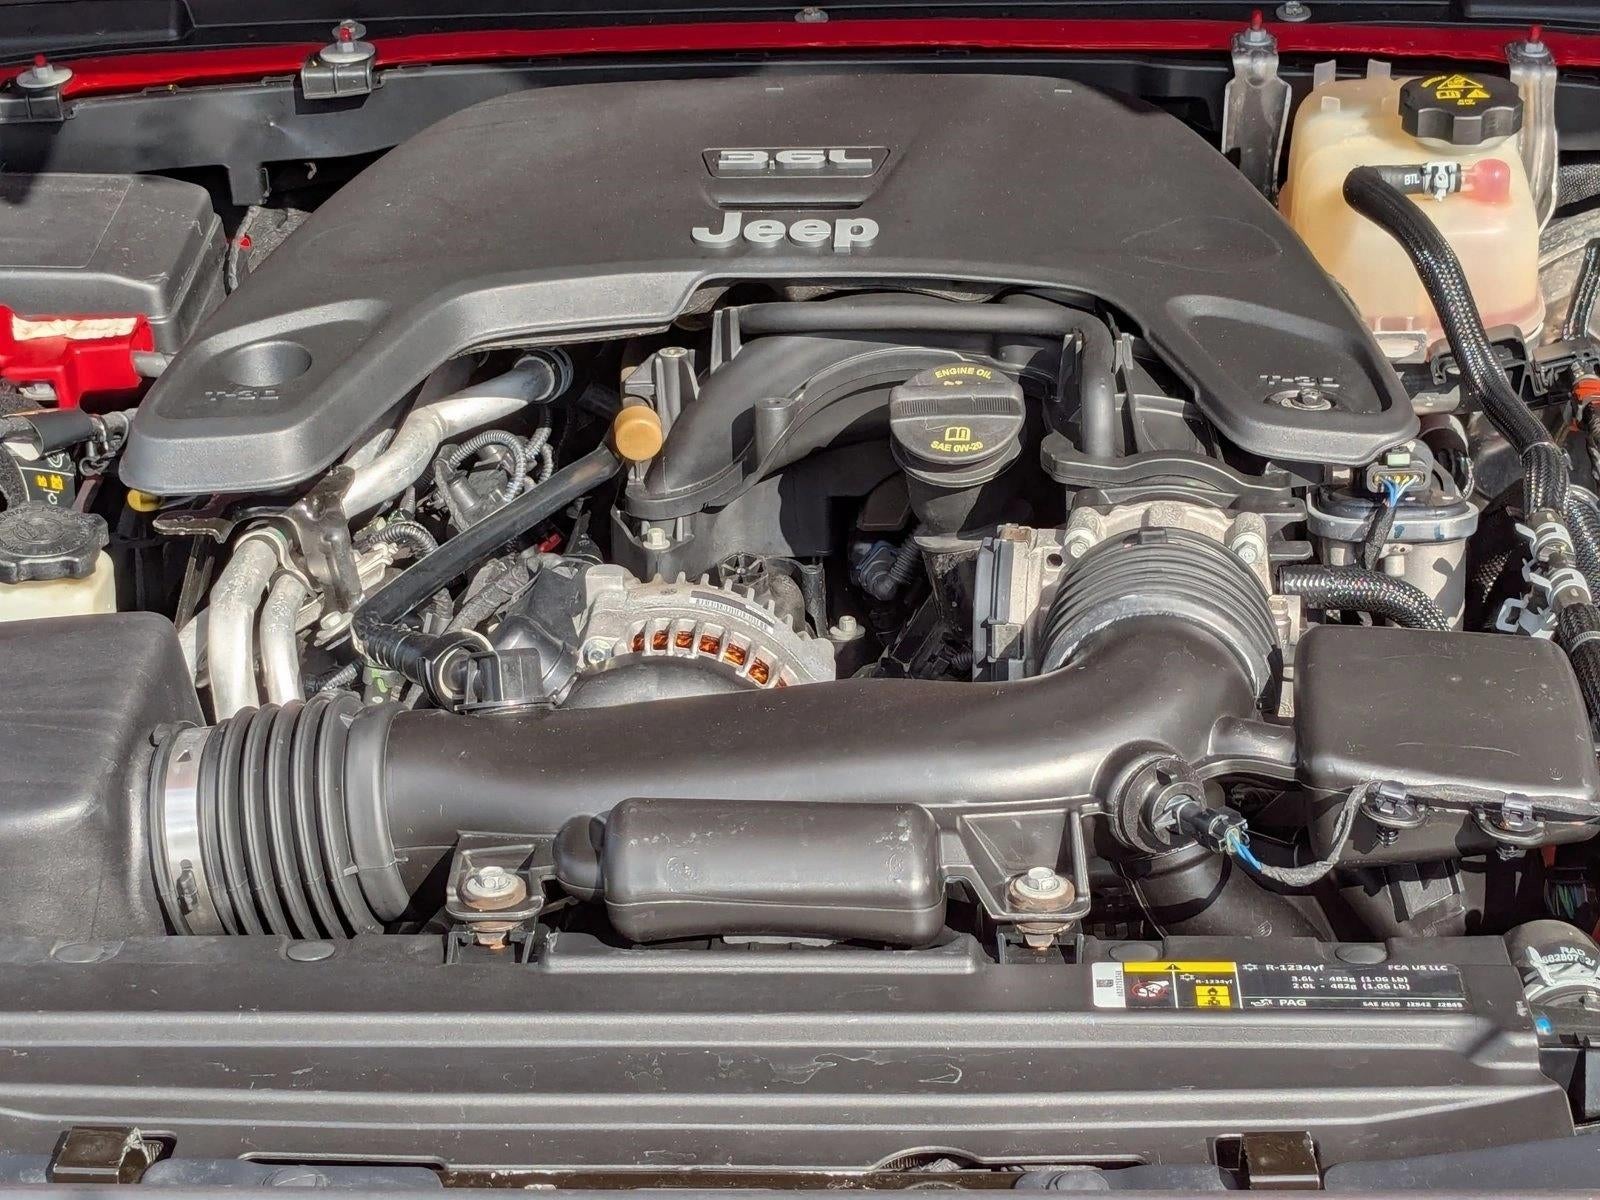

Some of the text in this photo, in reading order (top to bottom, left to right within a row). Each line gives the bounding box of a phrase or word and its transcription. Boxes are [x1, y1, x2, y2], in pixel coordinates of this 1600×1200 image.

[1404, 173, 1420, 186] BTL
[690, 211, 881, 253] Jeep
[935, 366, 992, 380] ENGINE OIL
[930, 440, 984, 453] SAE 0W-20
[1559, 946, 1586, 957] RAD
[1265, 964, 1325, 972] R-1234yf
[1279, 999, 1307, 1007] PAG
